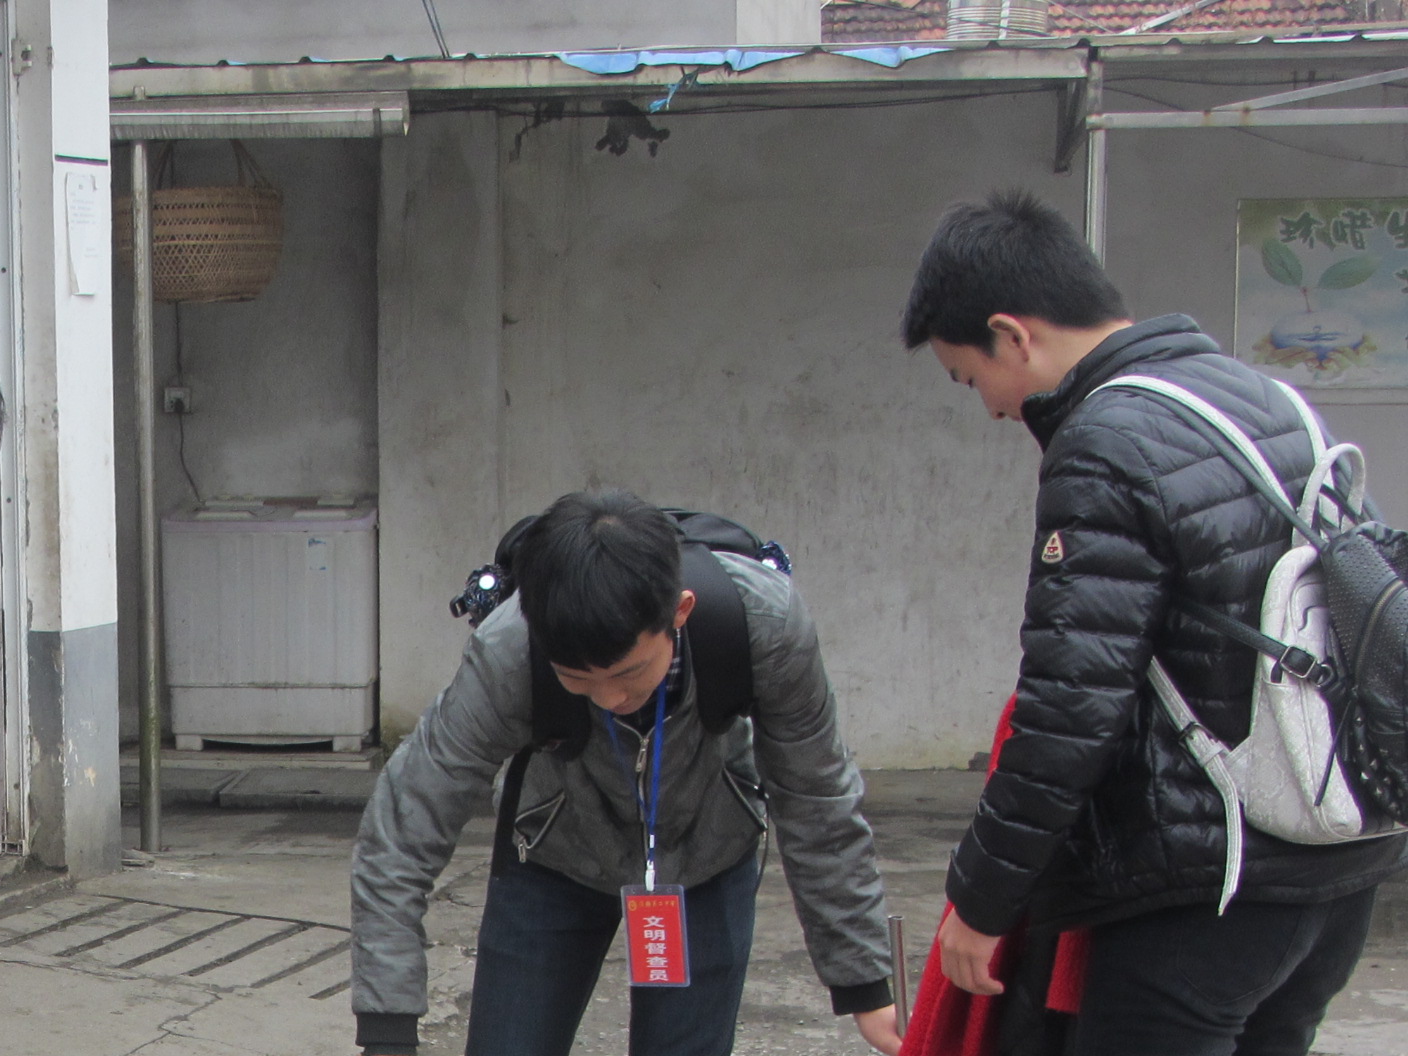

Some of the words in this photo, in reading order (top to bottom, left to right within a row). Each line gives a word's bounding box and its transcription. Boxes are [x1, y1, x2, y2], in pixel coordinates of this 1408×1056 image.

[643, 915, 669, 982] 文明督查员
